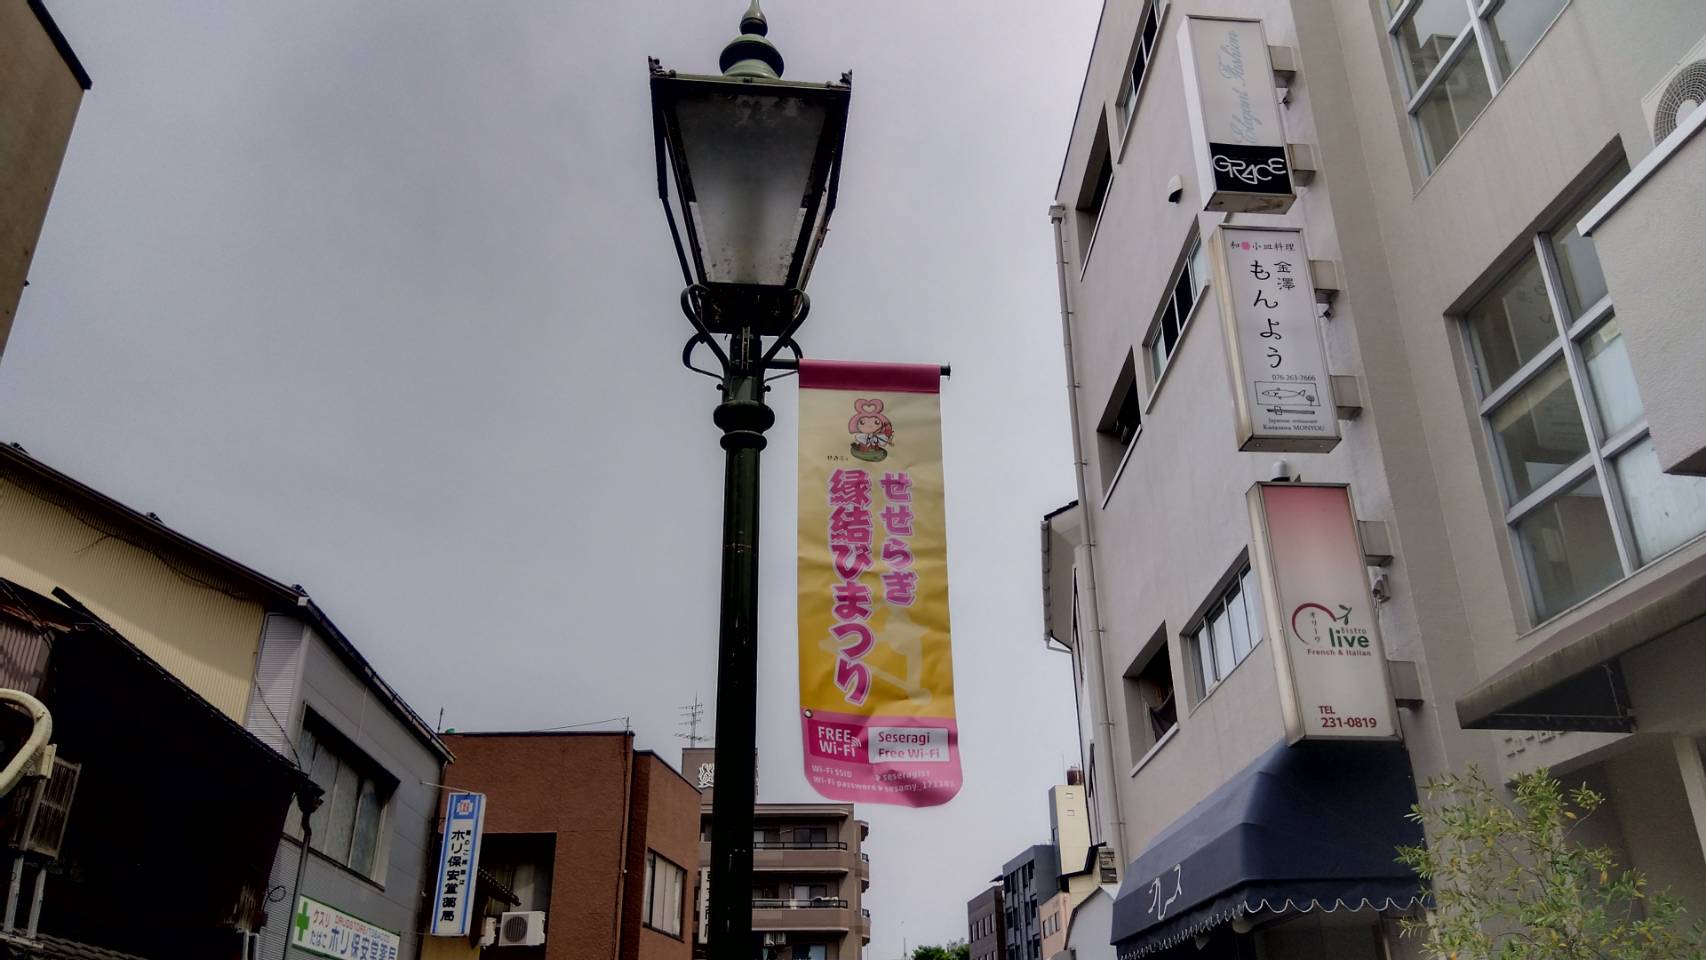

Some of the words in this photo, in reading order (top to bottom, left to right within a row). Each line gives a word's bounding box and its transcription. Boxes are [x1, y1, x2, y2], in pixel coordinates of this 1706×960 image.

[1219, 31, 1244, 82] Fashion
[1213, 155, 1287, 184] GRACE
[1250, 260, 1282, 368] もんよう
[880, 472, 919, 606] せせらぎ
[829, 468, 875, 706] 縁結びまつり
[1318, 705, 1336, 714] TEL
[1321, 717, 1377, 728] 231-0819
[818, 726, 850, 741] FREE
[878, 731, 931, 745] Seseragi
[819, 740, 856, 757] Wi-Fi
[878, 748, 905, 759] Free
[907, 747, 941, 758] Wi-Fi
[440, 830, 465, 921] ホリ保安堂薬局
[312, 909, 330, 928] クスリ
